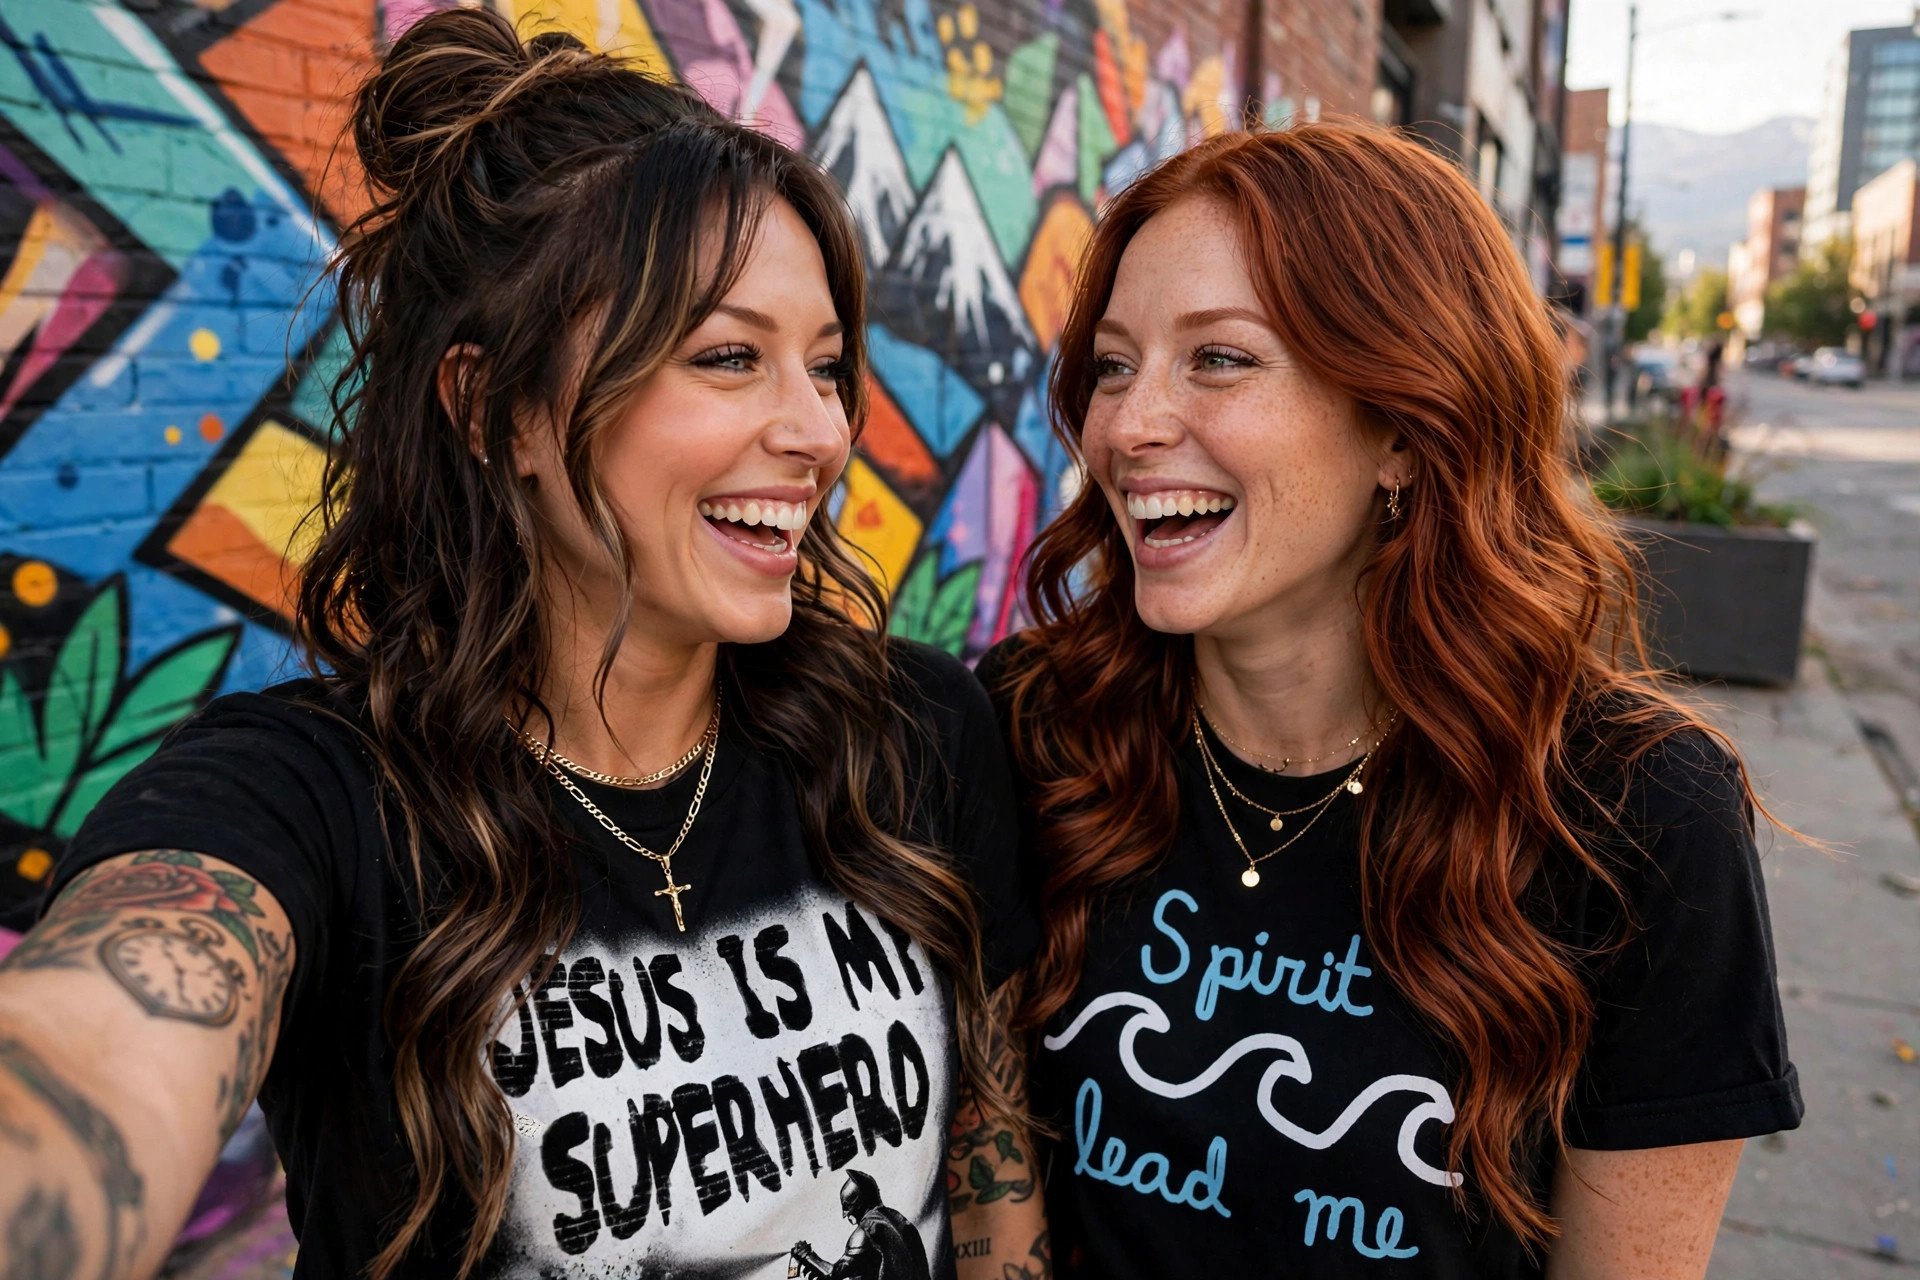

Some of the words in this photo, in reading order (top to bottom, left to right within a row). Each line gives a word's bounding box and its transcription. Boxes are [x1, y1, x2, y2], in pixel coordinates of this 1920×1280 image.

[486, 953, 706, 1098] JESUS
[716, 924, 813, 1039] IS
[1141, 889, 1374, 1021] Spirit
[539, 1019, 931, 1256] SUPERHERO
[1075, 1078, 1232, 1218] lead
[1294, 1189, 1419, 1259] me
